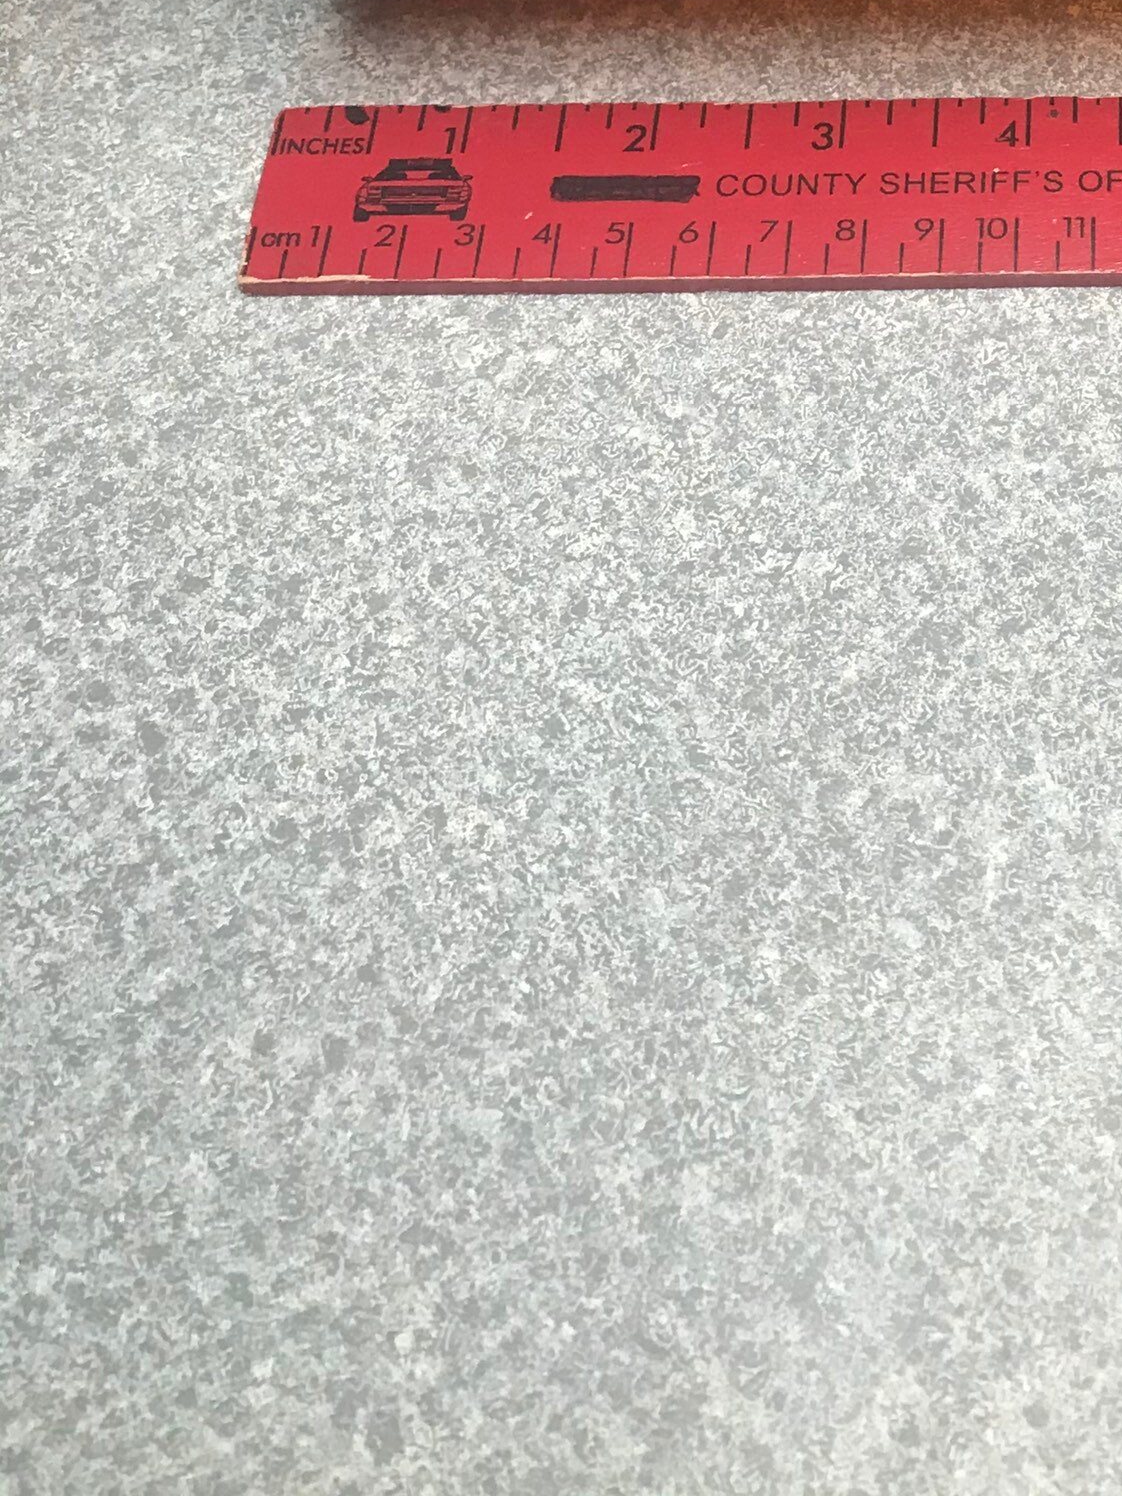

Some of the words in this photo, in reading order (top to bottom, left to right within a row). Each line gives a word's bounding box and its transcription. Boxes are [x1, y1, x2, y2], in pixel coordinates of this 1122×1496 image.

[279, 137, 366, 155] INCHES
[443, 127, 454, 153] 1
[622, 125, 648, 152] 2
[811, 122, 833, 150] 3
[995, 120, 1019, 147] 4
[716, 173, 866, 197] COUNTY
[879, 170, 1064, 195] SHERIFF'S
[261, 232, 301, 247] cm
[311, 225, 321, 247] 1
[374, 224, 396, 247] 2
[454, 225, 475, 246] 3
[531, 223, 553, 244] 4
[604, 222, 626, 244] 5
[679, 221, 698, 244] 6
[758, 220, 779, 242] 7
[835, 219, 856, 241] 8
[914, 218, 935, 241] 9
[975, 217, 1009, 240] 10
[1063, 216, 1087, 239] 11
